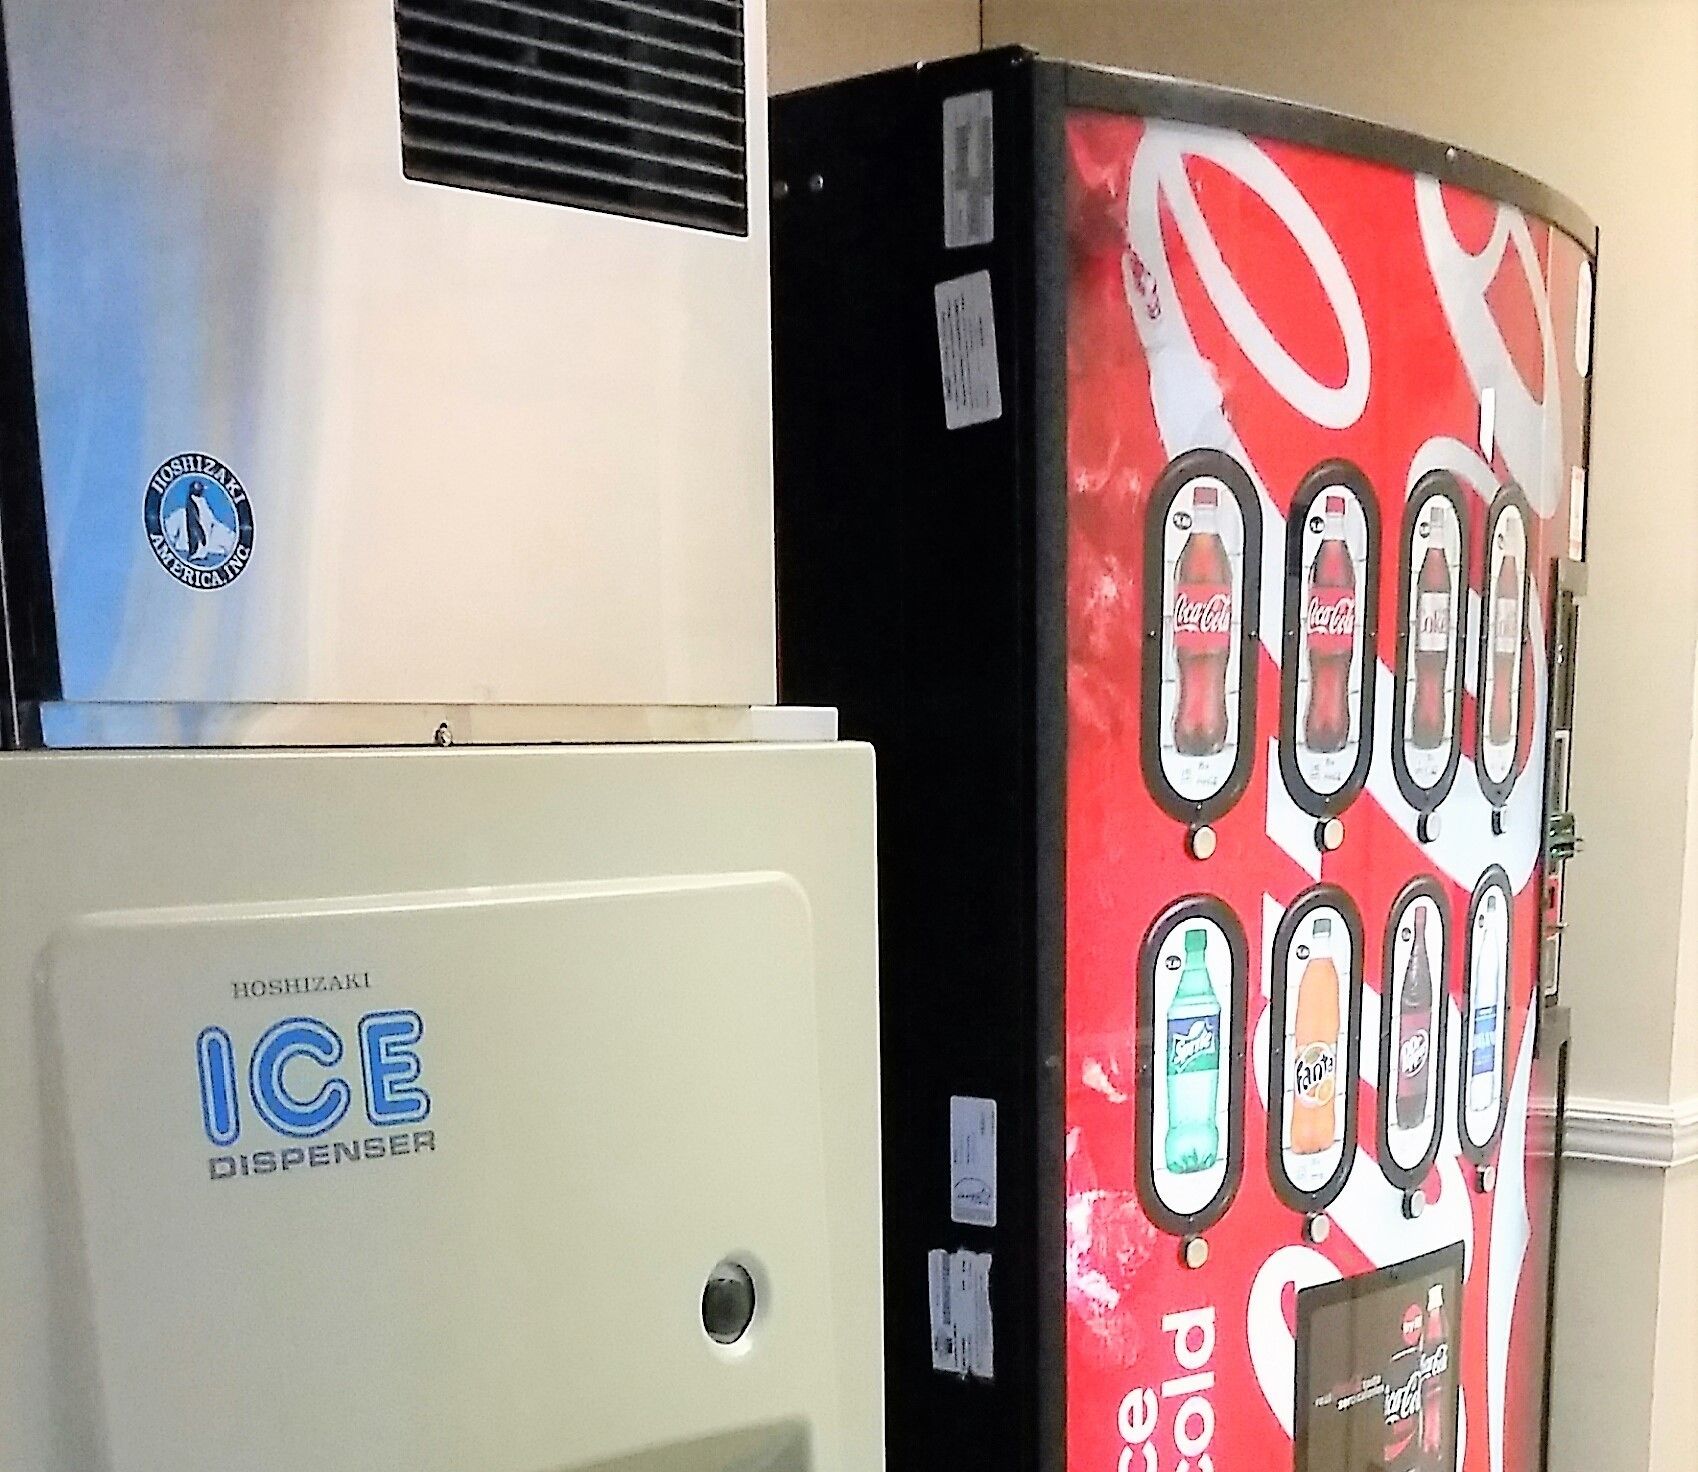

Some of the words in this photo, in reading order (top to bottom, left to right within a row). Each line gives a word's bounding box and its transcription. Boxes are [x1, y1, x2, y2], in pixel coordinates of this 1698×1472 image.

[152, 456, 246, 504] HOSHIZAKI
[231, 972, 371, 999] HOSHIZAKI
[196, 1008, 432, 1147] ICE
[208, 1129, 437, 1181] DISPENSER
